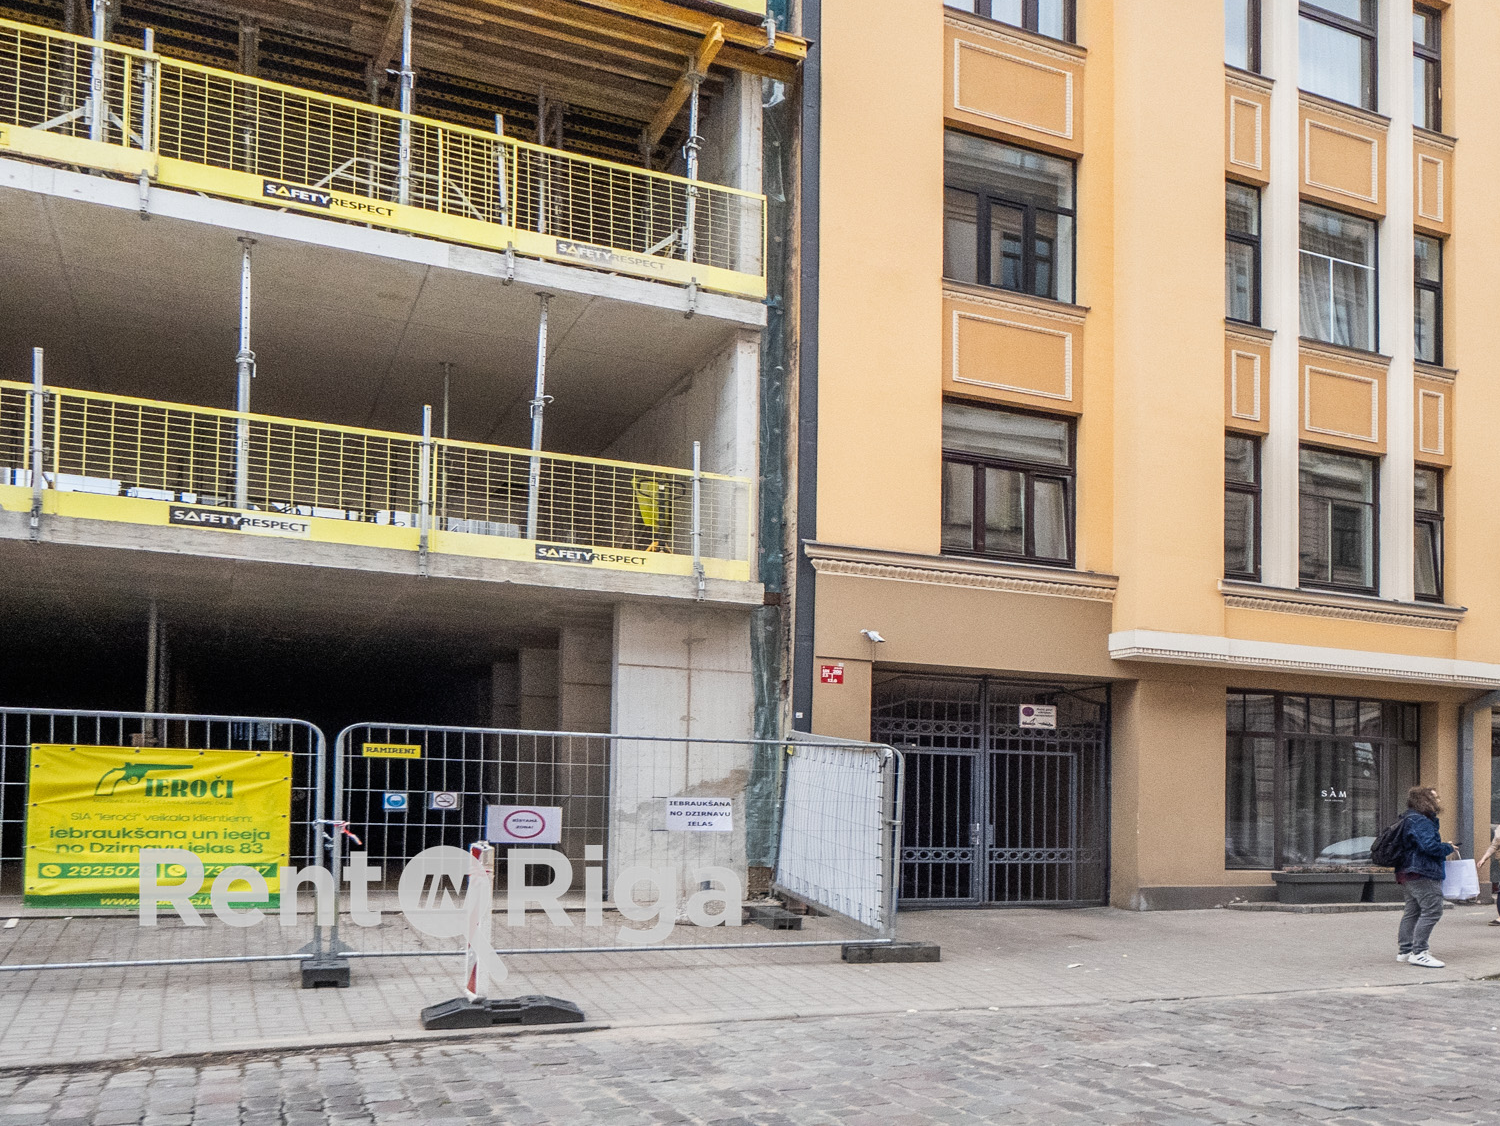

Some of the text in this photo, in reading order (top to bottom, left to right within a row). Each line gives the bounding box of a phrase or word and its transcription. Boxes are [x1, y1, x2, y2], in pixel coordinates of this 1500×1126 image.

[366, 746, 416, 755] RAMIRENT
[144, 775, 234, 799] IEROČI
[49, 826, 271, 843] iebraukšana un ieeja
[55, 844, 84, 854] no
[188, 842, 235, 854] ielas
[239, 843, 264, 854] 83
[67, 865, 156, 877] 292507
